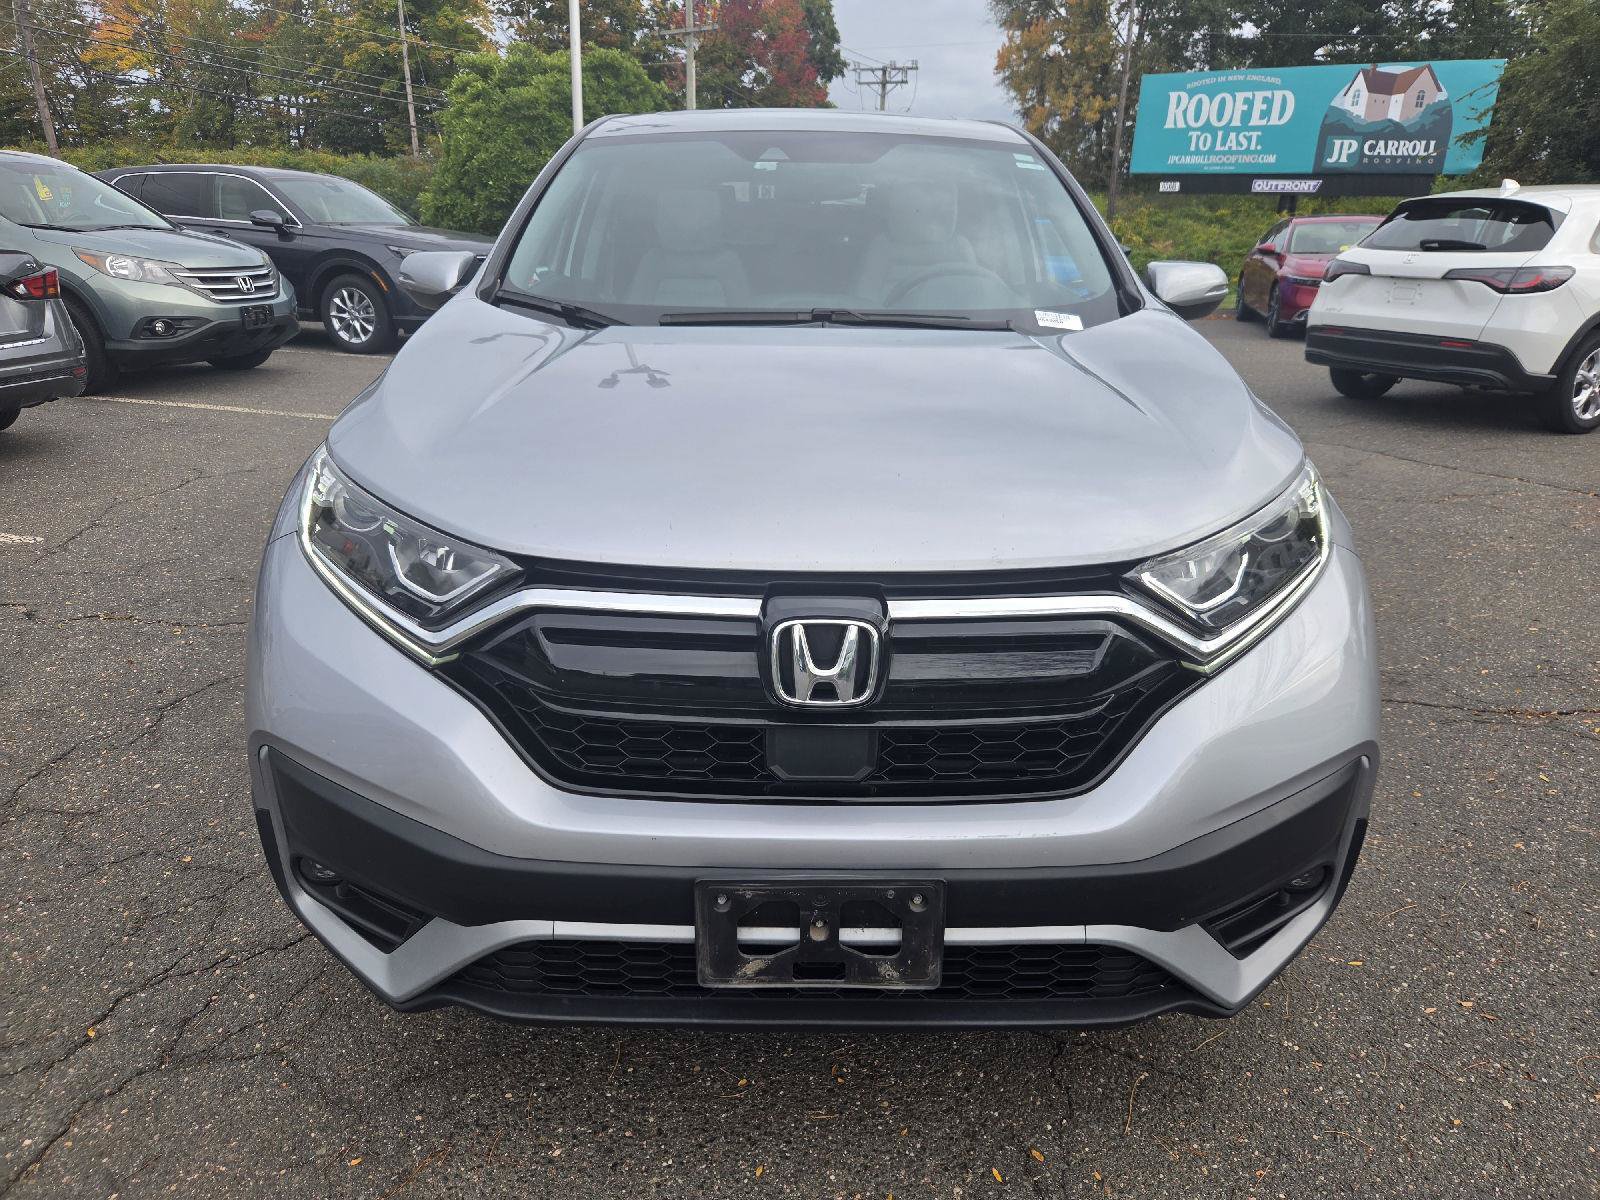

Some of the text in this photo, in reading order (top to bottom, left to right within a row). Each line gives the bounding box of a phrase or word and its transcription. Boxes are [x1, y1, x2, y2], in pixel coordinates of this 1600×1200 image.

[1246, 74, 1281, 85] ENGLAND
[1164, 90, 1295, 128] ROOFED
[1188, 131, 1262, 151] TO LAST.
[1326, 140, 1437, 163] JP CARROLL
[1168, 154, 1276, 165] JPCARROLLROOFING.COM
[1254, 181, 1316, 192] OUTFRONT
